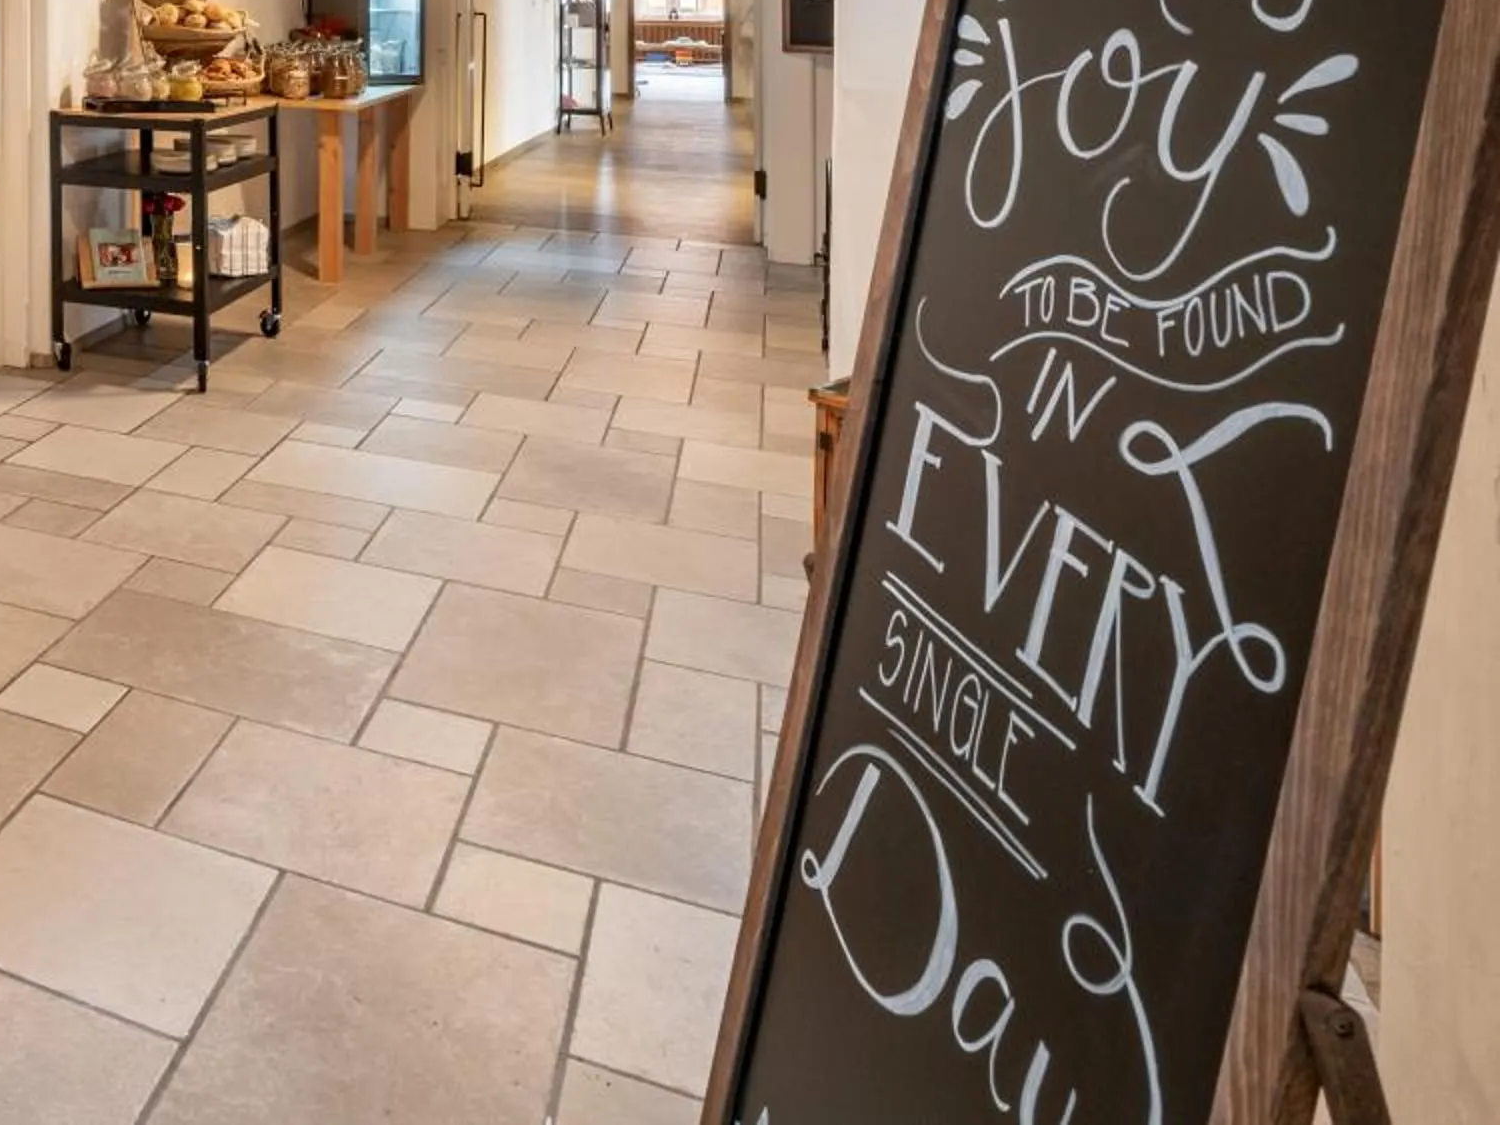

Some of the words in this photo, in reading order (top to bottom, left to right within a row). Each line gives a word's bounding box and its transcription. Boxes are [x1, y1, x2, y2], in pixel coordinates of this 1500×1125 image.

[1011, 277, 1055, 326] TO
[1066, 275, 1132, 347] BE
[1156, 271, 1311, 357] FOUND
[1026, 347, 1117, 442] IN
[885, 399, 1334, 817] EVERY
[878, 607, 1036, 827] SINGLE
